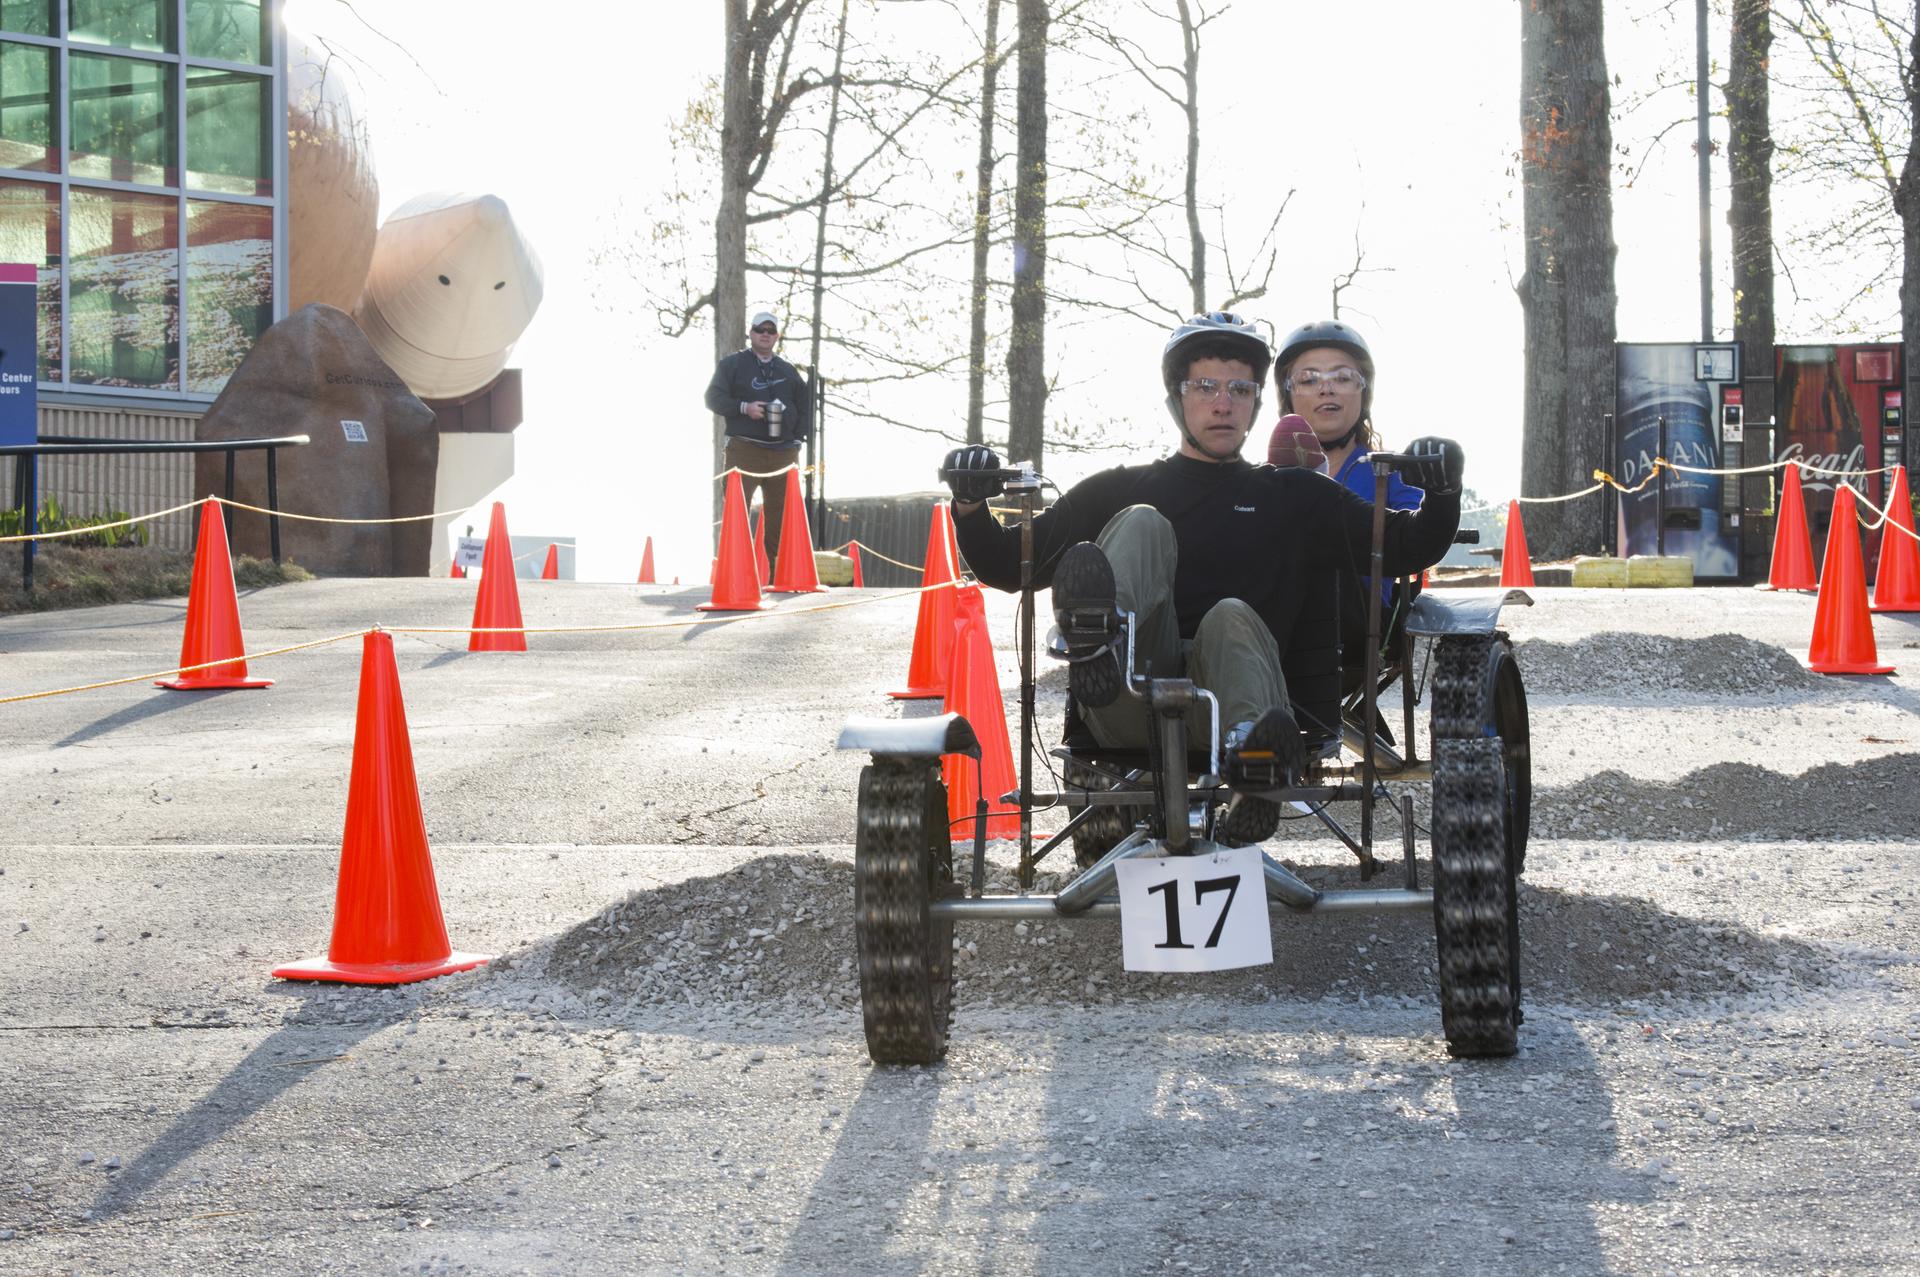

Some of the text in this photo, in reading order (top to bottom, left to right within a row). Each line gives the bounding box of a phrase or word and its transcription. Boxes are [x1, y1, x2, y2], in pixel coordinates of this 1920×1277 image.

[2, 373, 33, 383] Center
[0, 386, 20, 394] ours
[1148, 874, 1241, 949] 17
